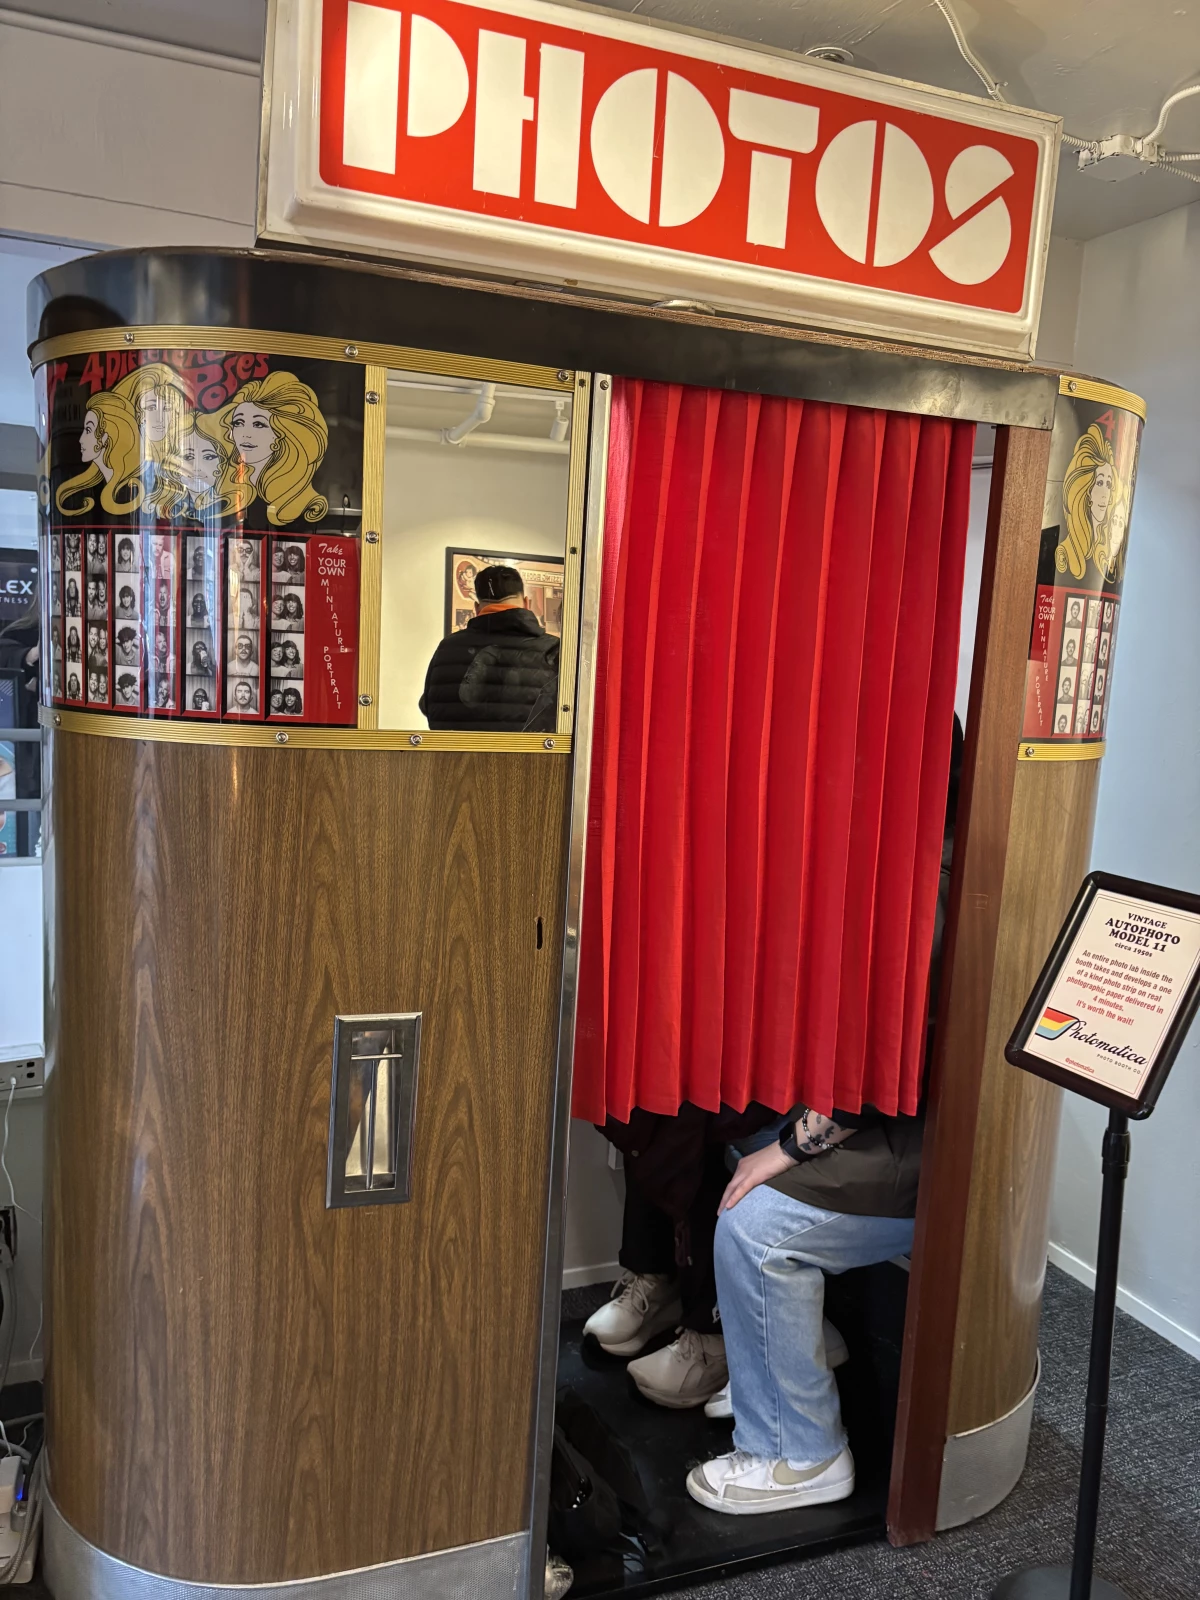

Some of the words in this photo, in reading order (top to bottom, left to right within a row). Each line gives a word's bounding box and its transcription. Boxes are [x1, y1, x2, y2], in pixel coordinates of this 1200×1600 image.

[342, 1, 1015, 286] PHOTOS
[79, 352, 105, 395] 4
[318, 556, 346, 568] YOUR
[318, 566, 346, 577] OWN
[320, 578, 345, 653] MINIATURE
[1038, 606, 1056, 614] YOUR
[1038, 613, 1055, 622] OWN
[323, 646, 342, 710] PORTRAIT
[1105, 918, 1181, 944] AUTOPHOTO
[1128, 913, 1168, 929] VINTAGE
[1108, 928, 1150, 948] MODEL
[1152, 943, 1167, 952] 11
[1114, 942, 1132, 951] circa
[1075, 958, 1093, 968] booth
[1093, 963, 1110, 974] takes
[1111, 970, 1124, 978] and
[1124, 974, 1152, 988] develops
[1158, 986, 1172, 994] one
[1082, 950, 1091, 958] An
[1092, 953, 1109, 963] entire
[1110, 959, 1128, 969] photo
[1129, 964, 1139, 973] lab
[1140, 967, 1160, 980] inside
[1160, 974, 1173, 983] the
[1066, 976, 1106, 994] photographic
[1106, 990, 1124, 1000] paper
[1125, 996, 1156, 1011] delivered
[1156, 1005, 1164, 1014] in
[1089, 972, 1103, 982] kind
[1103, 978, 1121, 989] photo
[1122, 984, 1137, 994] strip
[1147, 993, 1162, 1002] real
[1076, 1000, 1086, 1008] It's
[1087, 1004, 1105, 1015] worth
[1106, 1011, 1116, 1019] the
[1117, 1015, 1134, 1026] wait!
[1098, 997, 1124, 1012] minutes.
[1069, 1020, 1147, 1065] Photomatica
[1096, 1054, 1114, 1063] PHOTO
